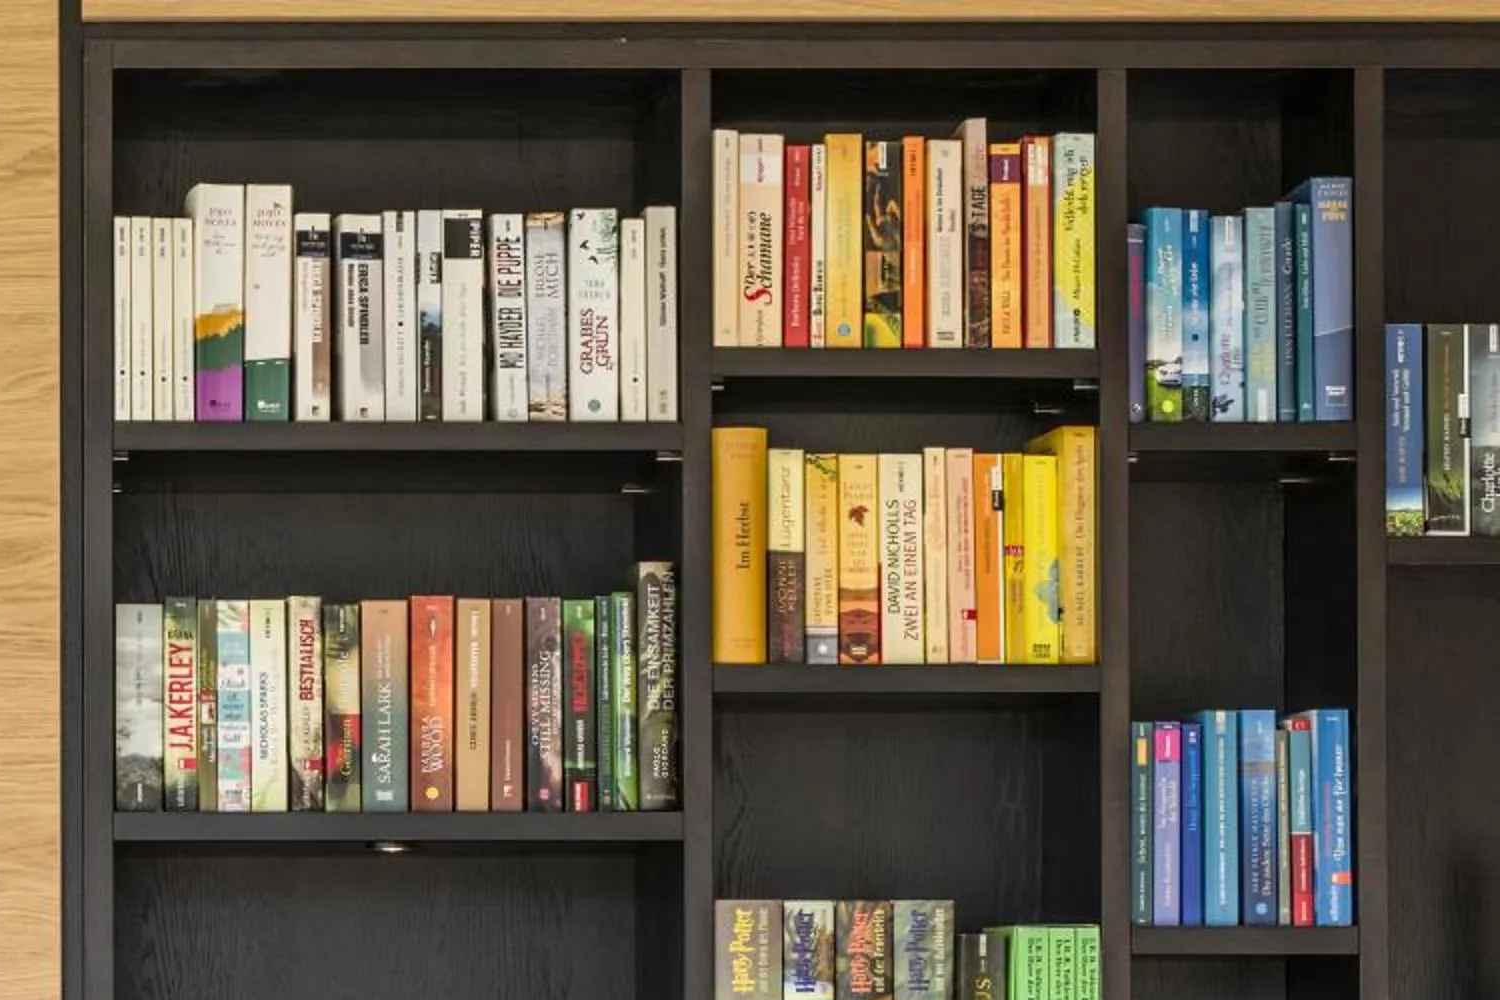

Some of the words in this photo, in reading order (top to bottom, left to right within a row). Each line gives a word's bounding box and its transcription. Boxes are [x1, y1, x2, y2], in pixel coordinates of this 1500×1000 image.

[497, 236, 520, 274] PUPPE
[546, 252, 558, 299] MICH
[743, 211, 773, 305] Schamane
[744, 260, 757, 285] Der
[499, 279, 522, 297] DIE
[499, 307, 522, 348] HAYDER
[580, 308, 594, 374] GRABES
[500, 353, 524, 368] MO
[1482, 453, 1495, 512] Charlotte
[737, 502, 751, 547] Herbst
[904, 499, 917, 525] TAG
[886, 499, 900, 568] NICHOLLS
[904, 530, 917, 576] EINEM
[737, 551, 751, 569] Im
[886, 571, 901, 614] DAVID
[904, 579, 917, 601] AN
[648, 583, 660, 679] EINSAMKEIT
[662, 571, 674, 673] PRIMZAHLEN
[904, 604, 919, 640] ZWEI
[299, 619, 315, 700] BESTIALISCH
[259, 672, 268, 708] SPARKS
[540, 650, 551, 713] MISSING
[648, 683, 660, 710] DIE
[662, 679, 674, 710] DER
[377, 682, 390, 724] LARK
[259, 710, 268, 759] NICHOLAS
[431, 715, 444, 772] WOOD
[540, 720, 550, 758] STILL
[376, 730, 391, 783] SARAH
[729, 907, 754, 952] Potter
[792, 911, 814, 953] Potter
[847, 910, 871, 953] Potter
[904, 909, 929, 953] Potter
[732, 954, 754, 993] Harry
[792, 955, 815, 993] Harry
[849, 955, 872, 993] Harry
[906, 954, 930, 991] Harry
